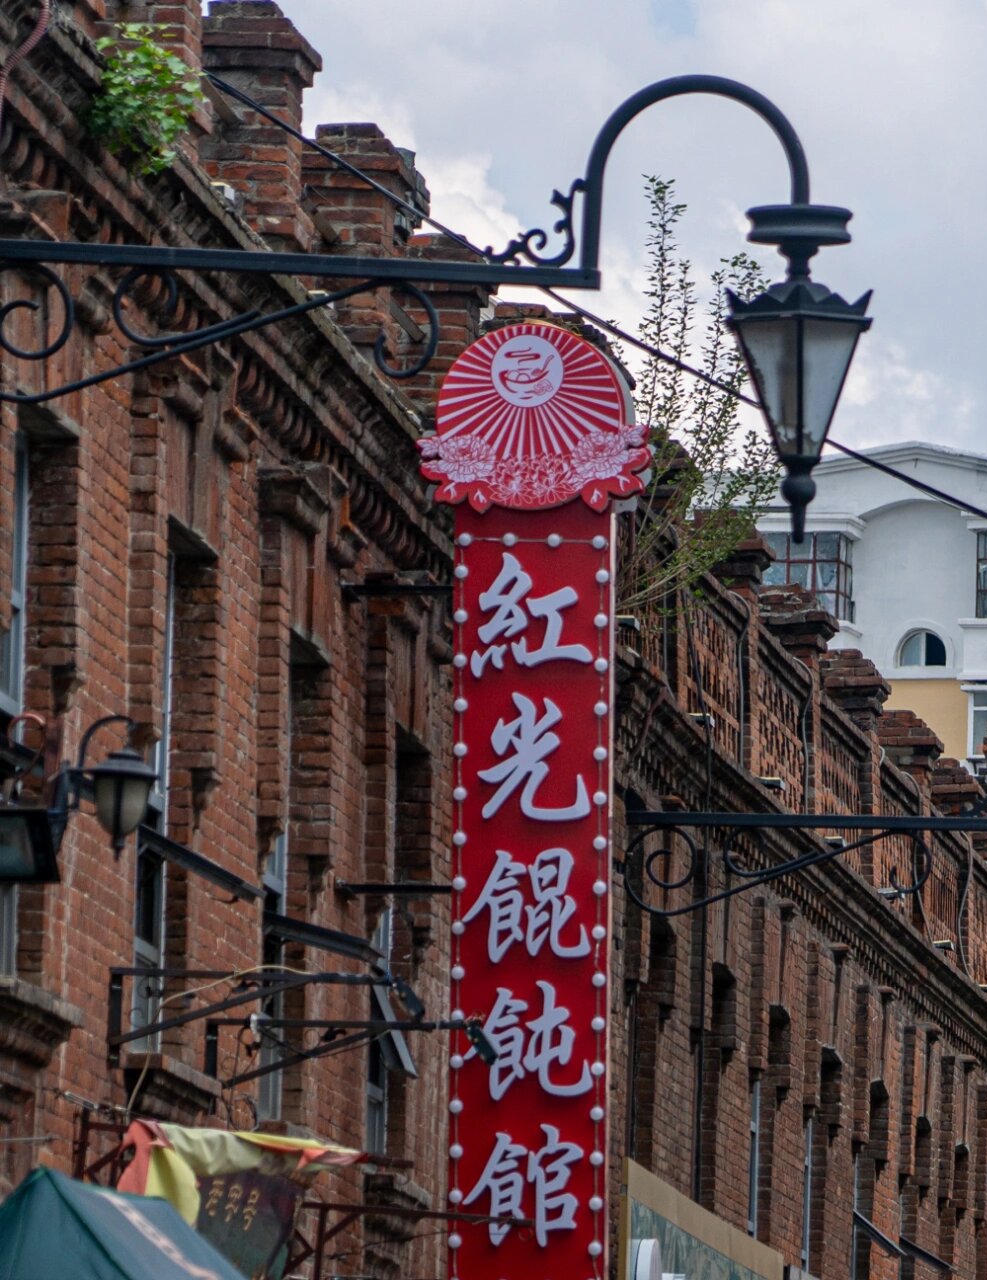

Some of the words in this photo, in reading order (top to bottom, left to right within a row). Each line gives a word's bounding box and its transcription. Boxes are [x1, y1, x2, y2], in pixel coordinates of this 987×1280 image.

[461, 552, 594, 1250] 紅光餛飩館
